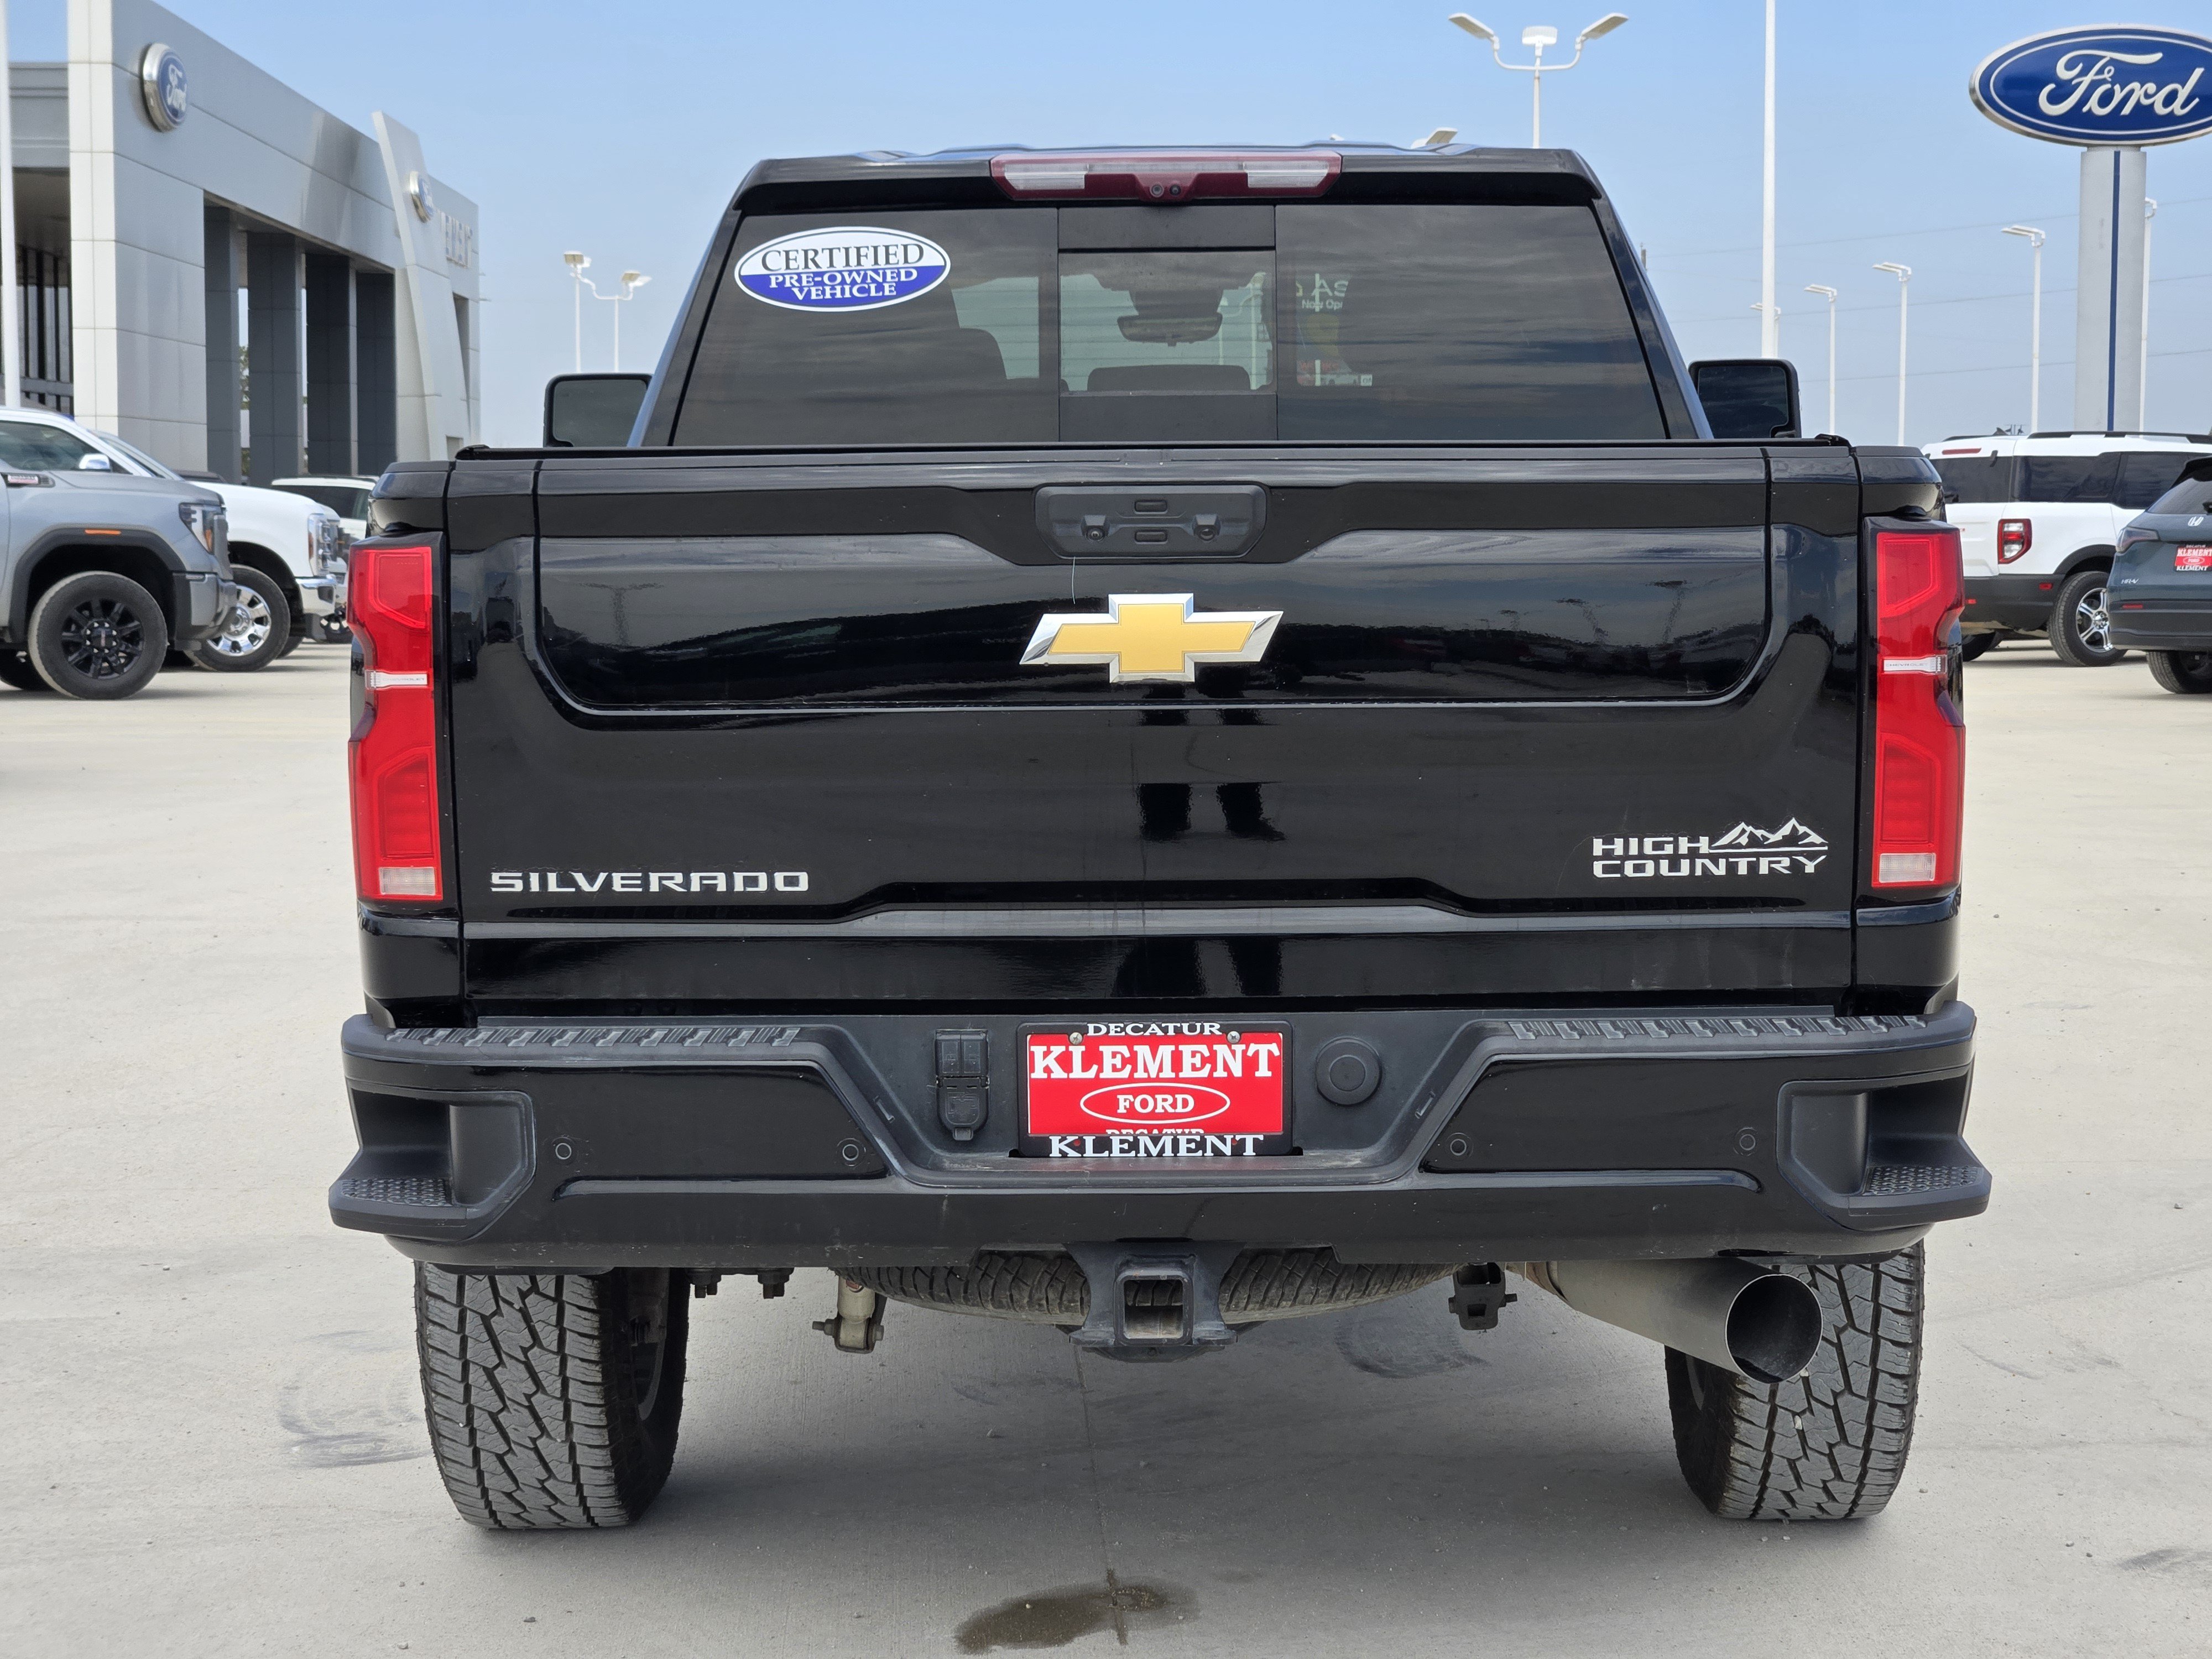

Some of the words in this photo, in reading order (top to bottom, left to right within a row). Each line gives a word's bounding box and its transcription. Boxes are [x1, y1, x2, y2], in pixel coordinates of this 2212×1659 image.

[2038, 50, 2204, 116] Ford
[761, 243, 924, 272] CERTIFIED
[769, 268, 917, 288] PRE-OWNED
[791, 282, 897, 300] VEHICLE
[1593, 836, 1709, 856] HIGH
[1593, 855, 1827, 878] COUNTRY
[490, 872, 808, 892] SILVERADO
[1087, 1022, 1223, 1036] DECATUR
[1030, 1042, 1280, 1079] KLEMENT
[1117, 1094, 1194, 1114] FORD
[1048, 1134, 1264, 1157] KLEMENT
